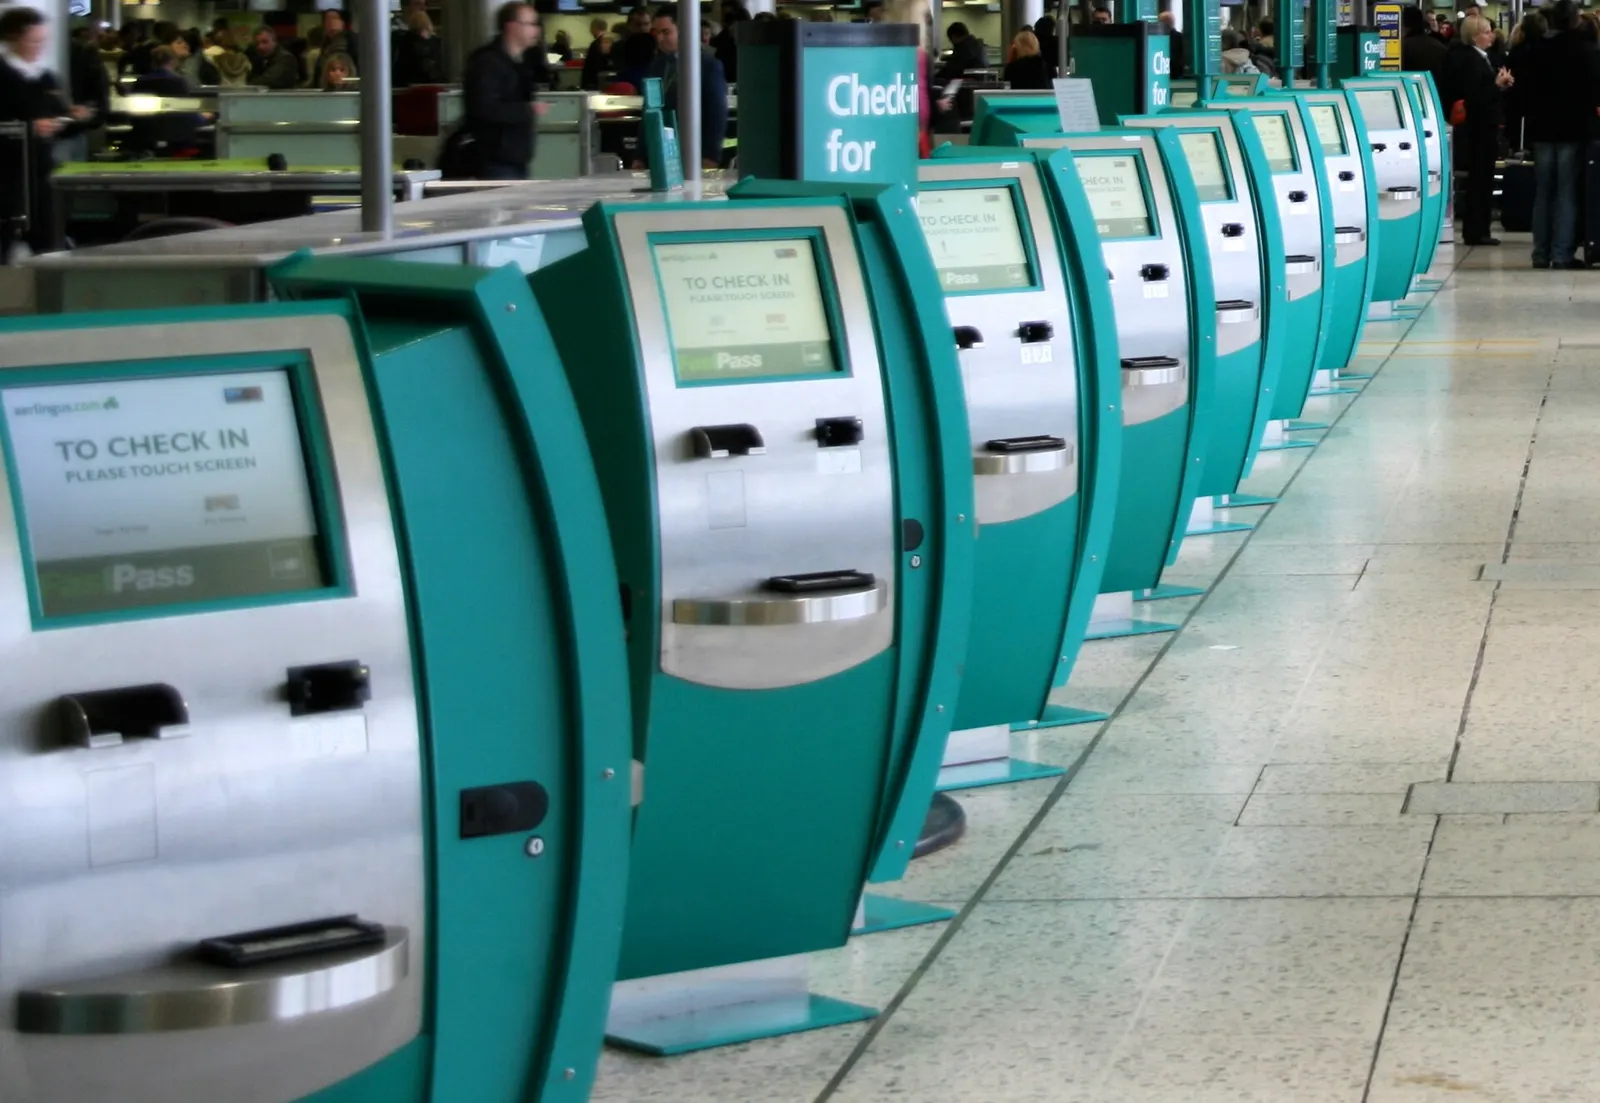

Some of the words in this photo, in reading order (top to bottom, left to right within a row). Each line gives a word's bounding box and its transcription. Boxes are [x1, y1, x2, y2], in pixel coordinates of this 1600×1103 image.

[1364, 56, 1376, 70] for
[1152, 81, 1167, 105] for
[827, 129, 876, 172] for
[940, 214, 980, 225] CHECK
[683, 277, 707, 290] TO
[712, 274, 769, 289] CHECK
[773, 273, 791, 286] IN
[946, 271, 979, 285] Pass
[716, 352, 763, 370] Pass
[55, 439, 98, 463] TO
[107, 430, 211, 458] CHECK
[218, 427, 250, 450] IN
[65, 466, 128, 484] PLEASE
[131, 462, 192, 479] TOUCH
[194, 456, 258, 473] SCREEN
[112, 563, 196, 593] Pass
